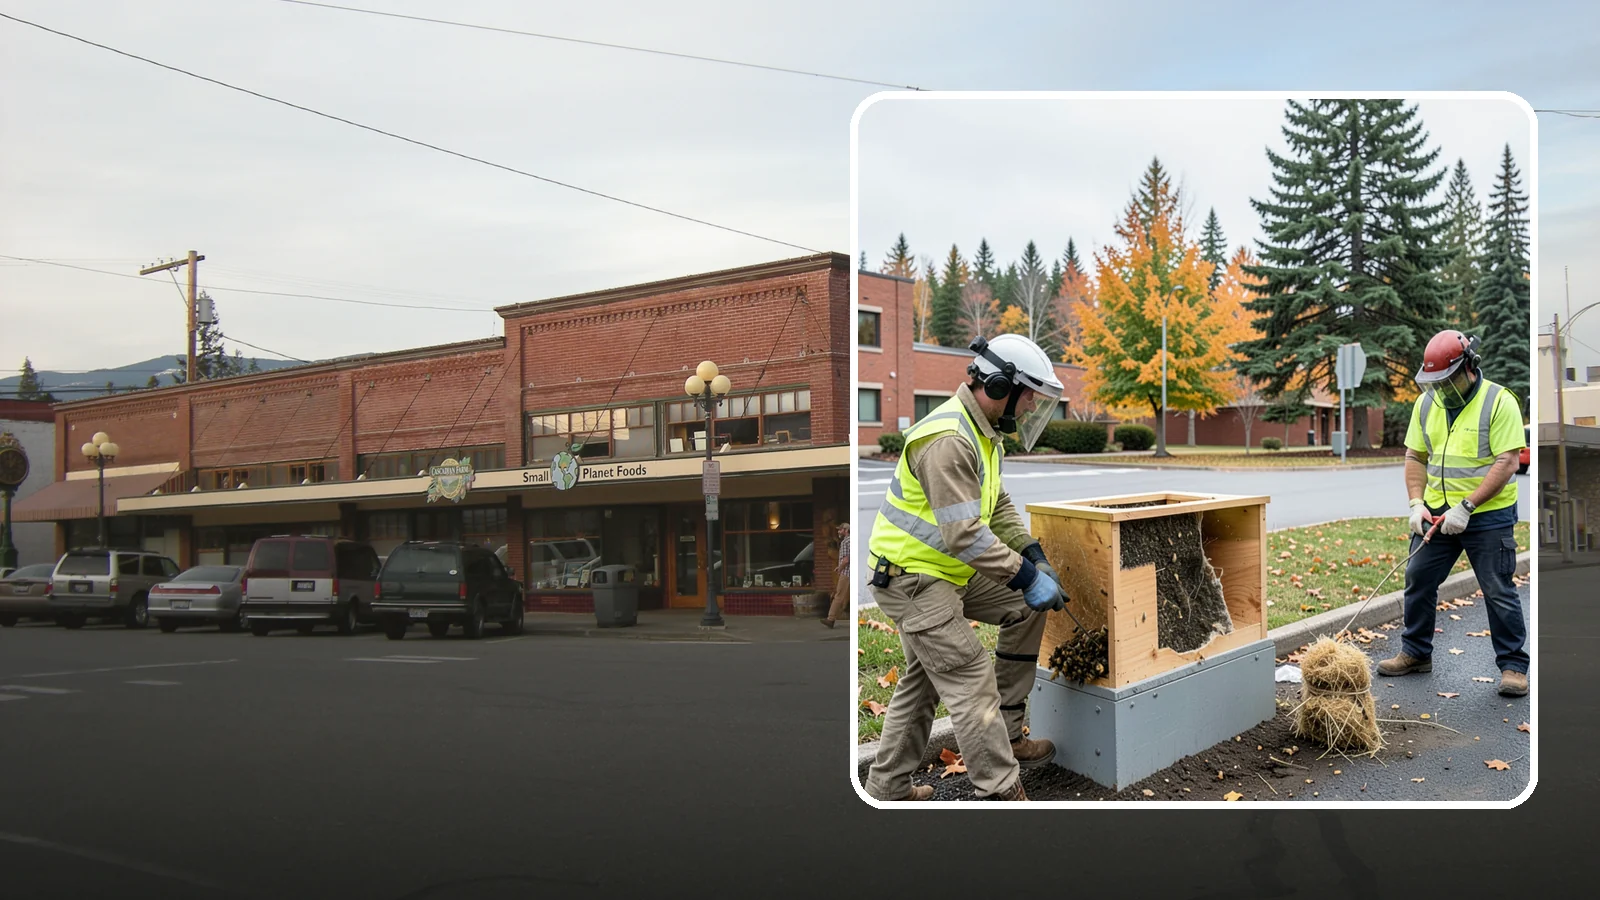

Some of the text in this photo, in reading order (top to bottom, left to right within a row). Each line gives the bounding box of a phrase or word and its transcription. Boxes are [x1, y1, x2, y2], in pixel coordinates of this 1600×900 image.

[522, 464, 647, 483] Small Planet Foods
